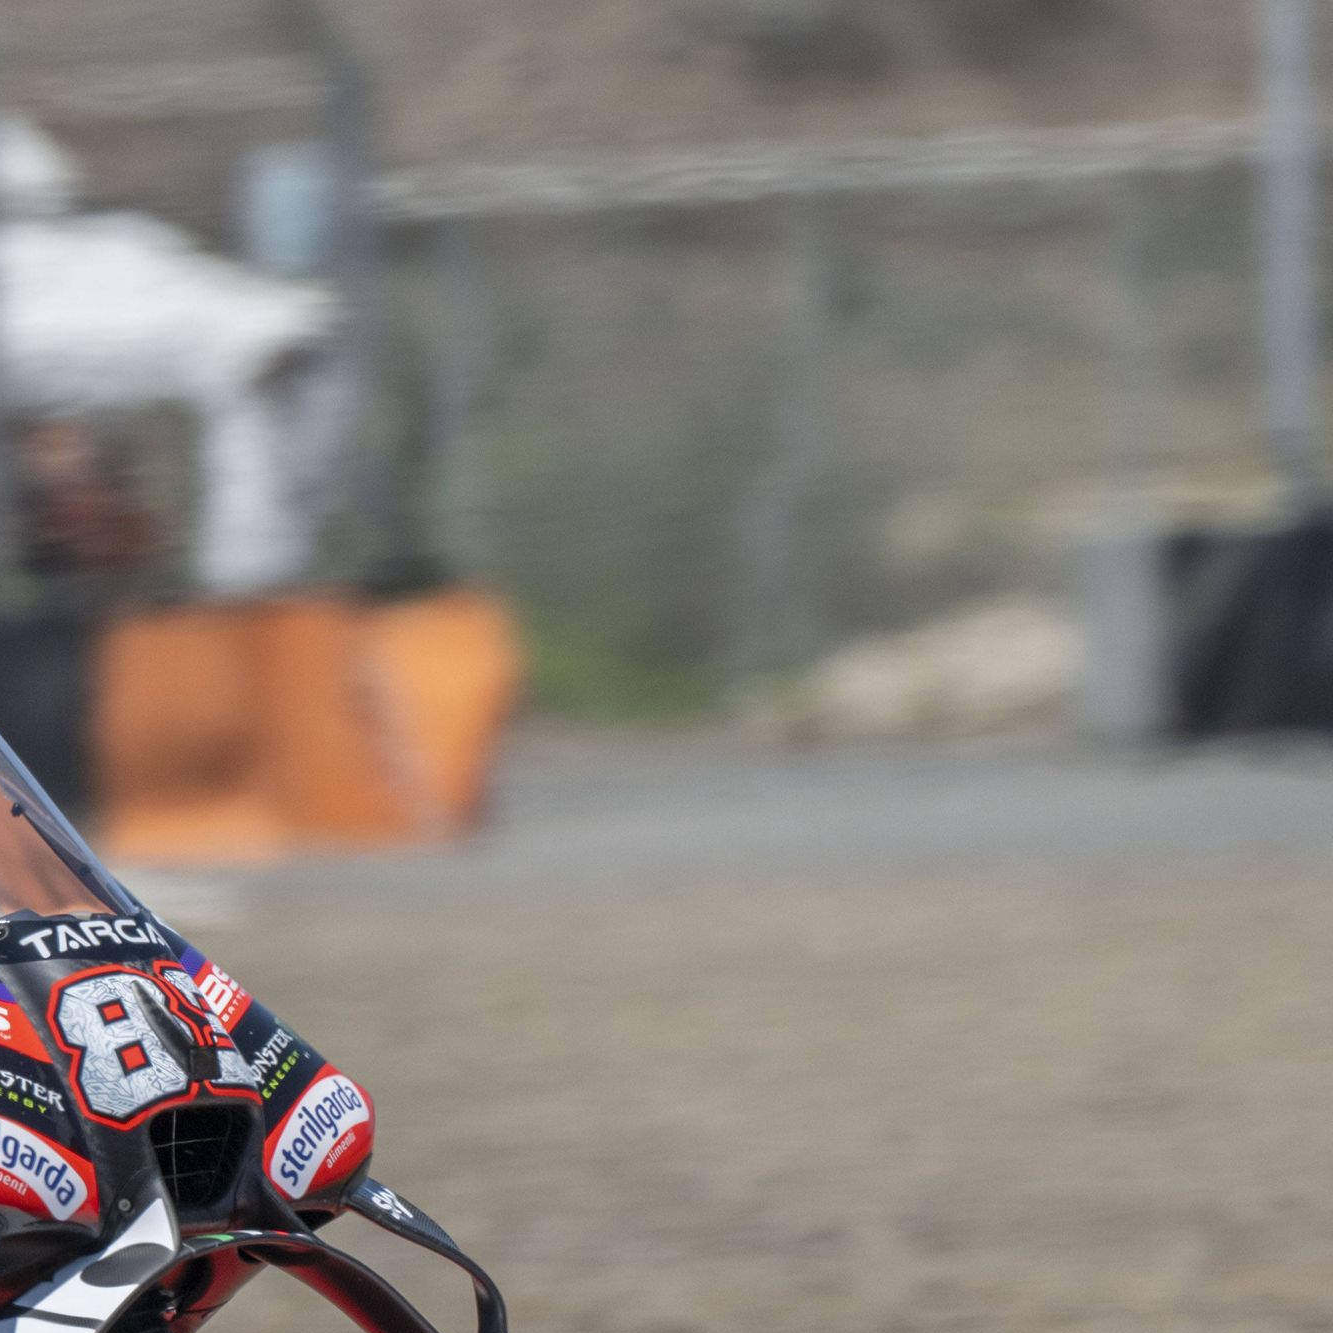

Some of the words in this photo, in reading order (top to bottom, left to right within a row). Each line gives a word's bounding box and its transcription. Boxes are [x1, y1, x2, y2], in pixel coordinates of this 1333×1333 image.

[249, 1028, 293, 1085] ONSTER
[279, 1080, 363, 1187] sterilgarda
[325, 1131, 357, 1170] alimenti
